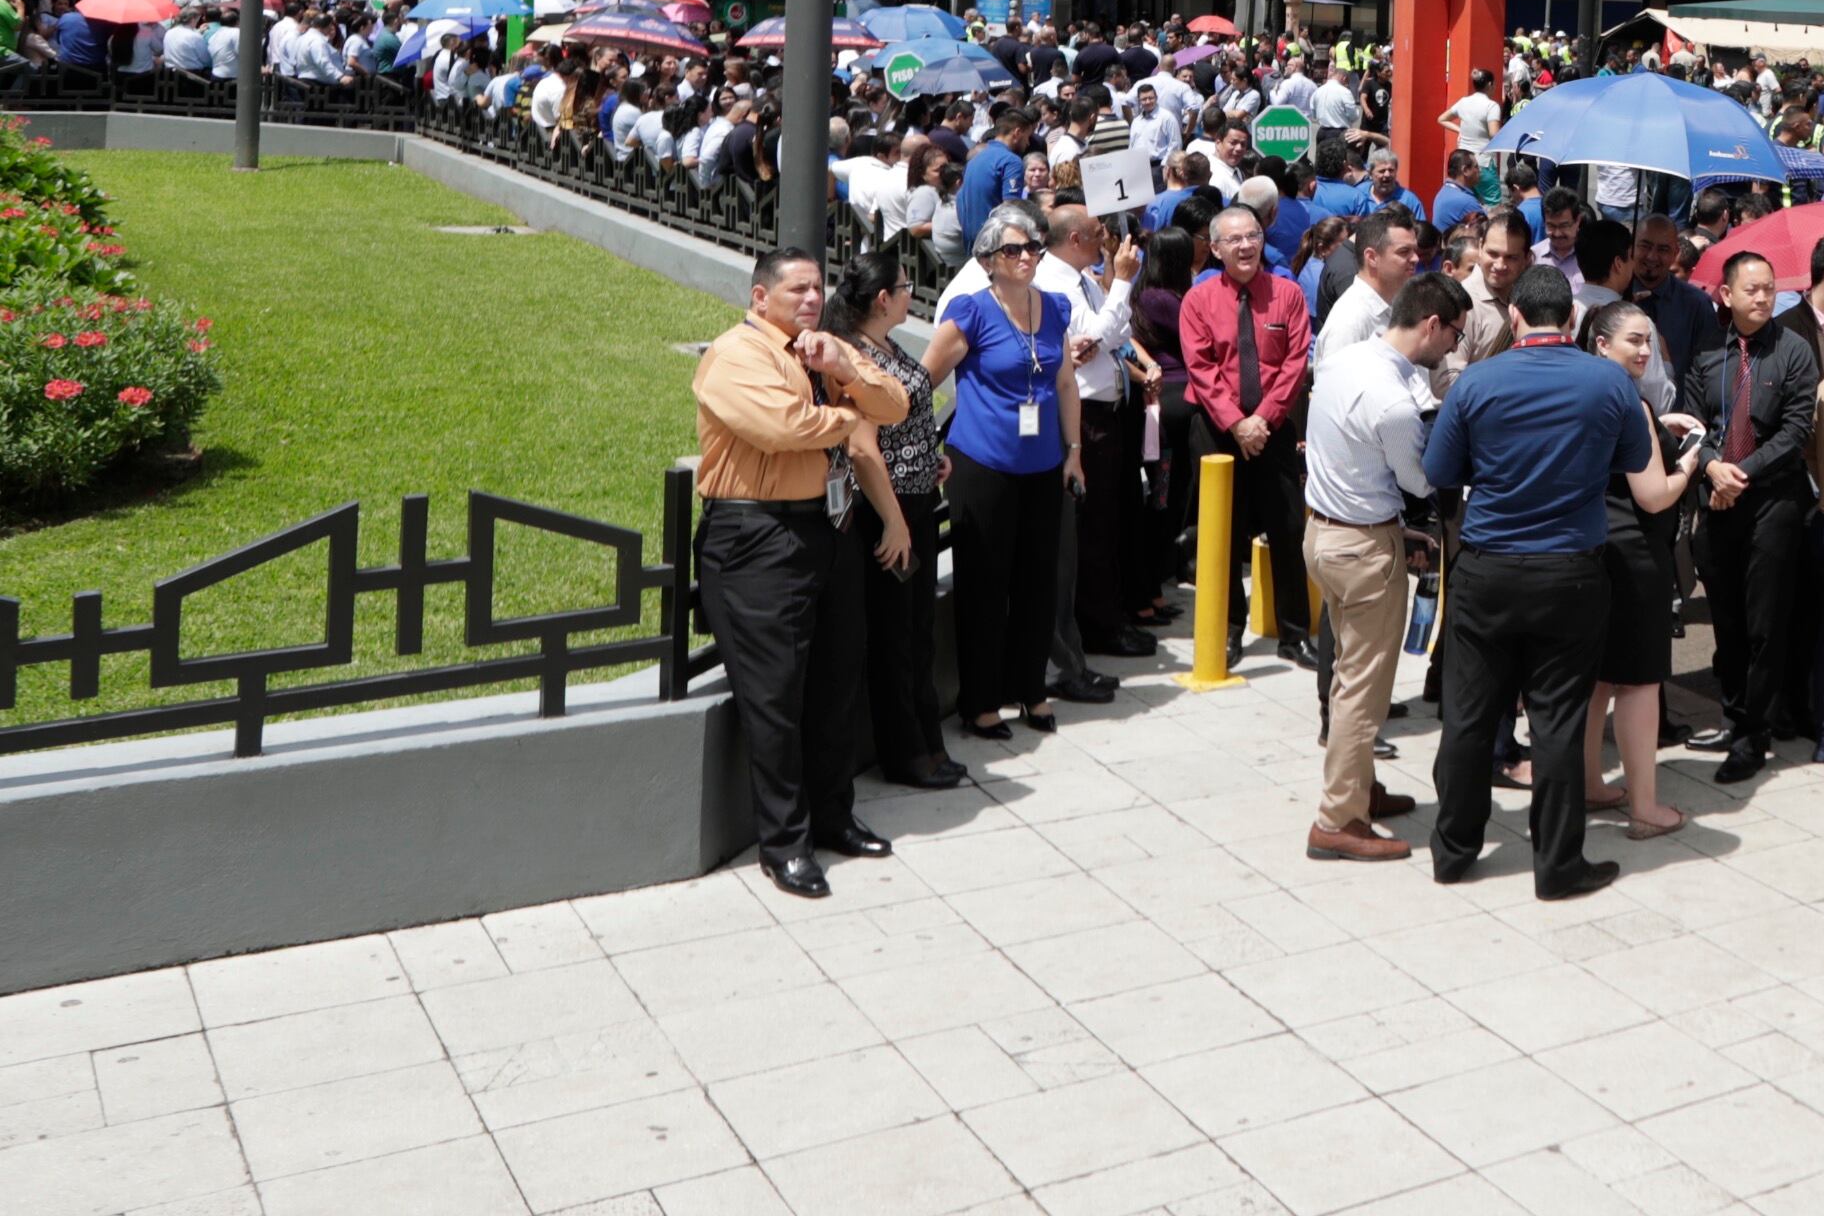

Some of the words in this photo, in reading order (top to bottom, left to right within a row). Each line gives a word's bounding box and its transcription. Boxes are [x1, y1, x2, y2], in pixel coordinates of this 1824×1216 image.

[891, 69, 914, 84] PISO
[1256, 126, 1308, 141] SOTANO
[1114, 178, 1129, 201] 1
